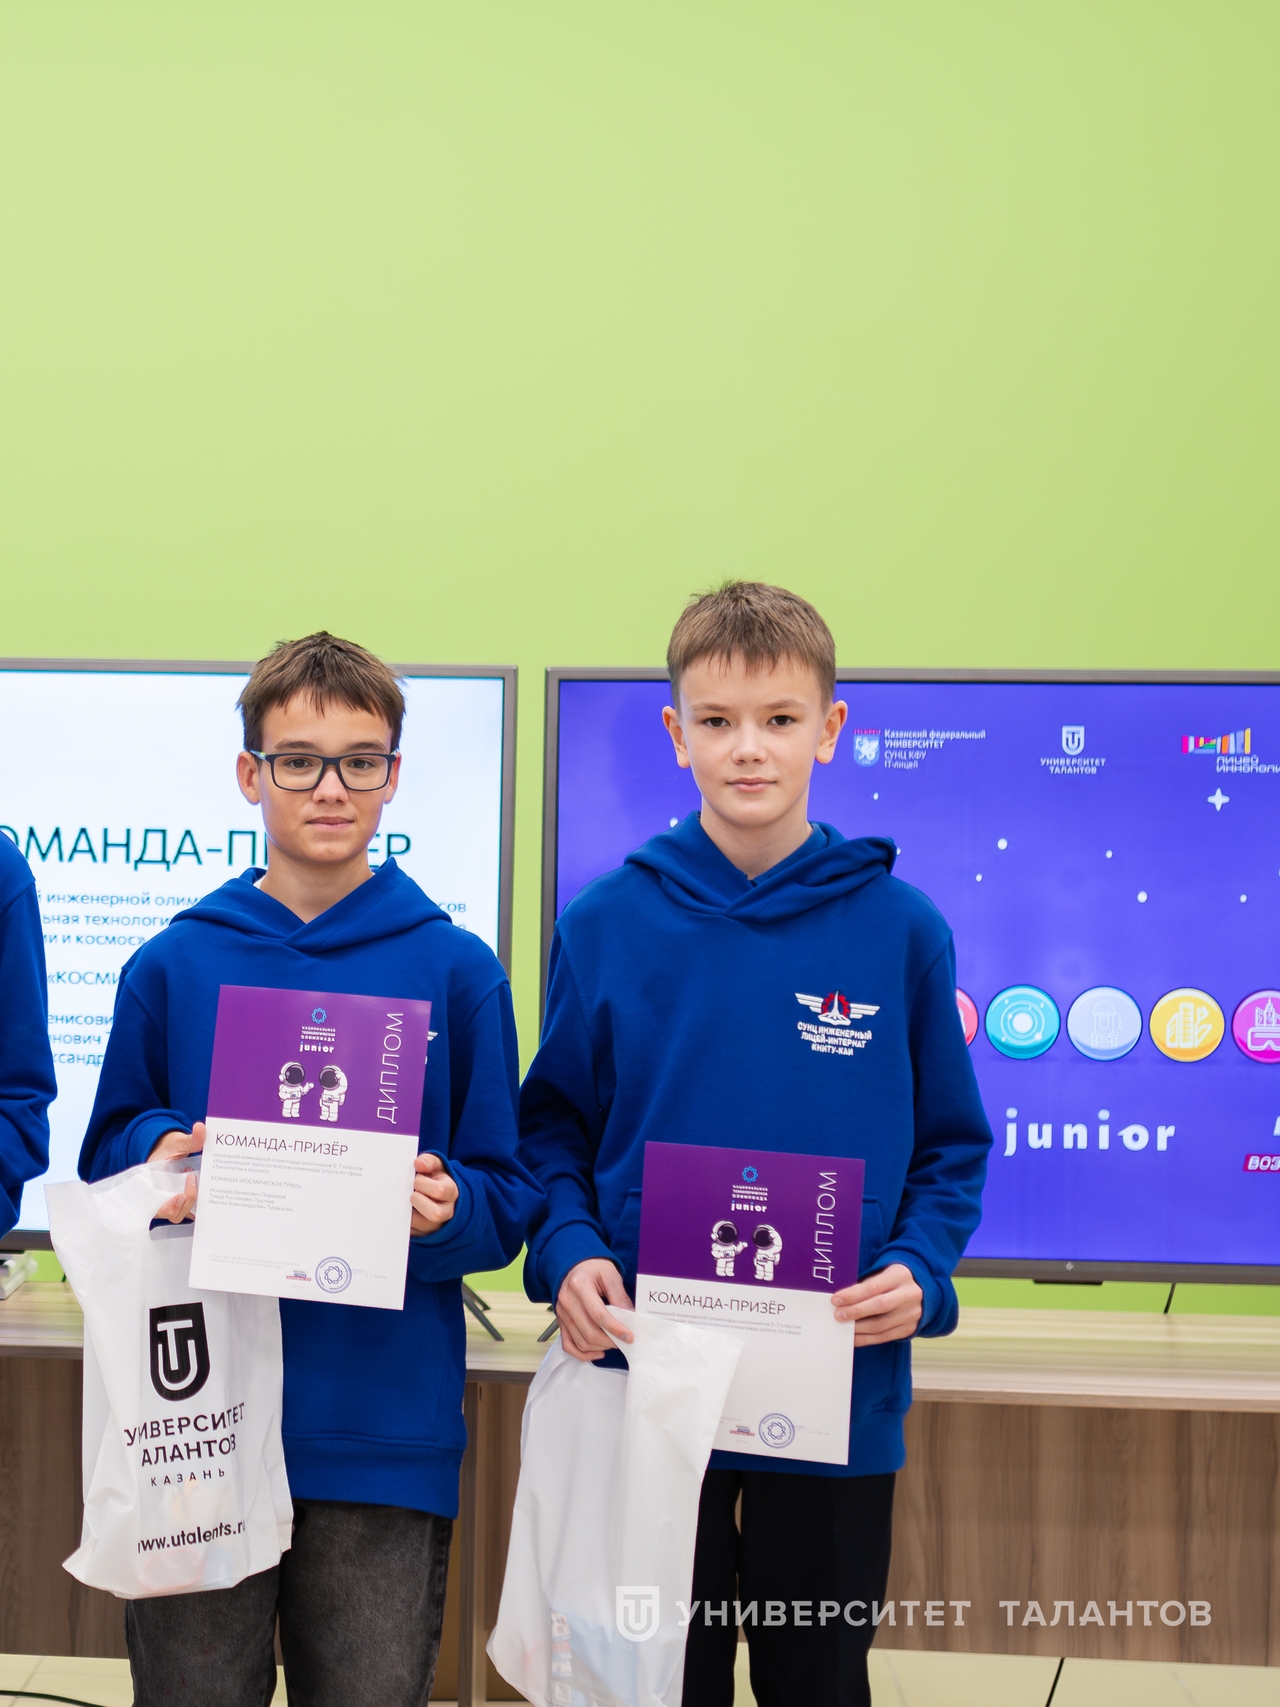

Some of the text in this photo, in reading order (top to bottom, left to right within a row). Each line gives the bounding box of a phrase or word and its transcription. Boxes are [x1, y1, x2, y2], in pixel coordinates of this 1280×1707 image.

[884, 728, 927, 740] Казанский
[929, 728, 986, 741] федеральный
[884, 739, 944, 749] УНИВЕРСИТЕТ
[910, 750, 927, 760] КФУ
[1040, 757, 1107, 767] УНИВЕРСИТЕТ
[1049, 766, 1097, 775] ТАЛАНТОВ
[47, 891, 150, 908] инженерной
[154, 894, 203, 907] олим
[62, 934, 71, 944] и
[76, 934, 146, 946] космос»
[797, 1021, 872, 1040] СУНЦ ИНЖЕНЕРНЫЙ
[49, 1033, 102, 1045] нович
[801, 1031, 867, 1048] ЛИЦЕЙ-ИНТЕРНАТ
[299, 1041, 335, 1053] junior
[811, 1043, 854, 1056] КНИТУ-КАИ
[376, 1013, 404, 1124] ДИПЛОМ
[1004, 1107, 1176, 1157] junior
[215, 1134, 348, 1156] КОМАНДА-ПРИЗЁР
[731, 1200, 767, 1212] junior
[812, 1171, 837, 1284] ДИПЛОМ
[648, 1291, 785, 1315] КОМАНДА-ПРИЗЁР
[124, 1402, 245, 1446] УИВЕРСИТЕТ
[150, 1468, 225, 1487] КАЗАНЬ
